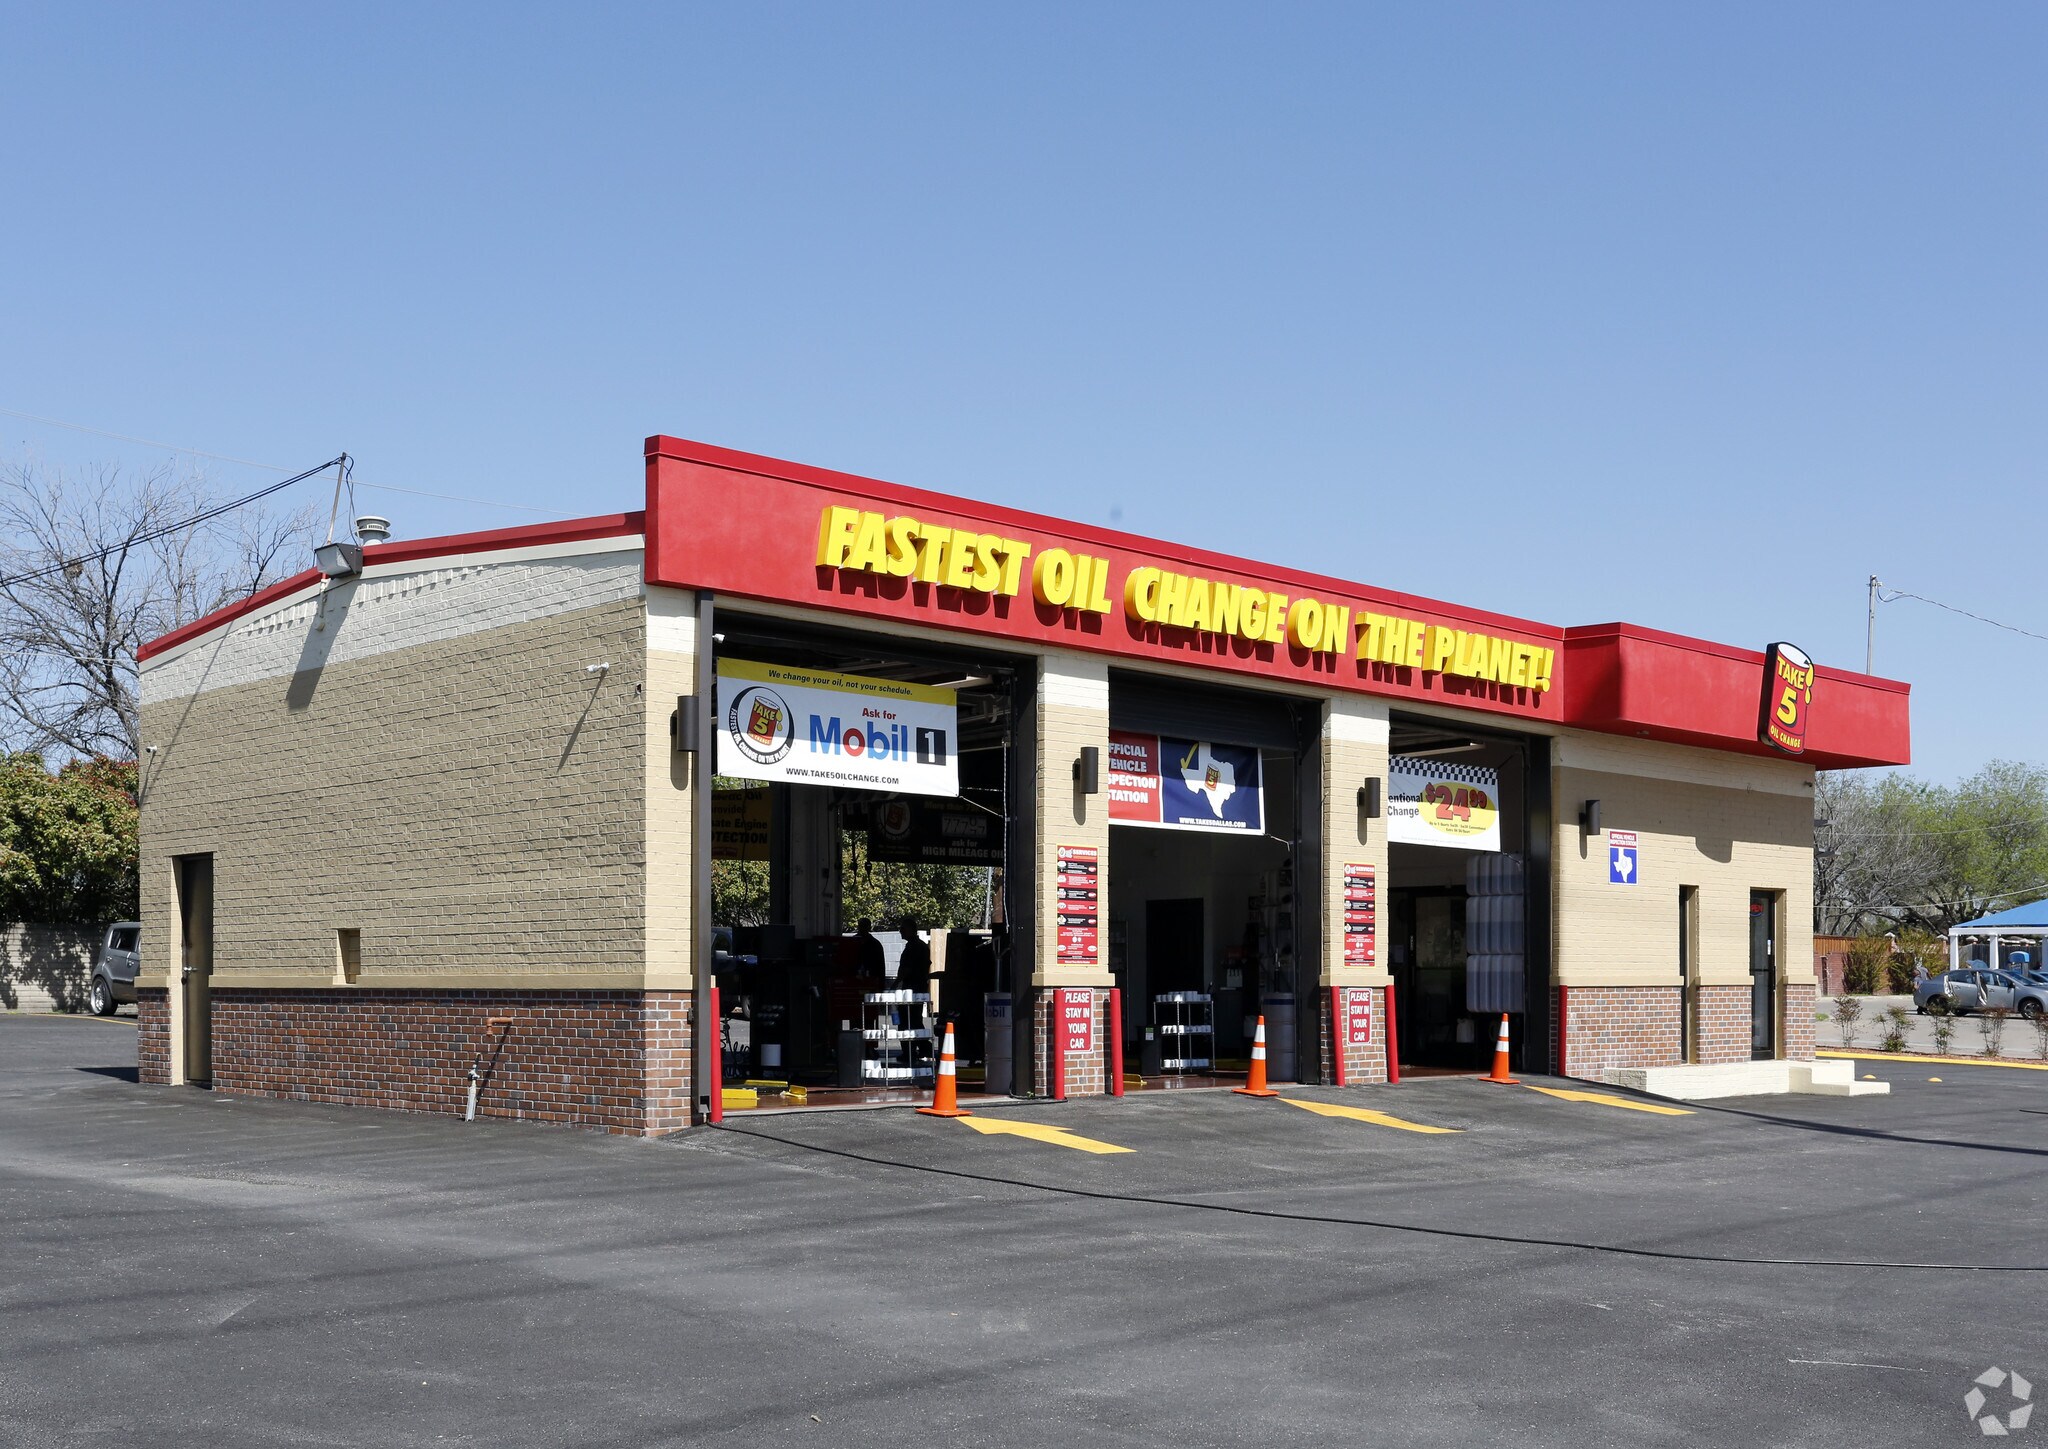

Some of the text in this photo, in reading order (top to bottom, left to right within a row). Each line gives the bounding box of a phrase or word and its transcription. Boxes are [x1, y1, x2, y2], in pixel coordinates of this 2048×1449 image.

[816, 505, 1555, 693] FASTEST OIL CHANGE ON THE PLANET!
[1777, 655, 1806, 690] TAKE
[768, 670, 913, 696] We change your oil, not your schedule.
[753, 702, 776, 721] TAKE
[1776, 686, 1797, 727] 5
[862, 707, 897, 720] Ask for
[753, 717, 769, 735] 5
[809, 714, 908, 762] Mobil
[1770, 725, 1801, 748] OIL CHANGE
[1108, 742, 1148, 757] FFICIAL
[786, 767, 900, 785] WWW.TAKE5OILCHANGE.COM
[1108, 773, 1157, 789] SPECTION
[1388, 792, 1424, 803] entional
[711, 804, 746, 814] rovides
[1387, 806, 1419, 818] Change
[735, 818, 768, 831] Engine
[711, 831, 768, 844] TECTION
[951, 839, 978, 848] ask for
[922, 846, 946, 856] HIGH
[948, 847, 989, 858] MILEAGE
[1065, 992, 1090, 1004] PLEASE
[1350, 992, 1370, 1002] PLEASE
[1065, 1007, 1090, 1018] STAY IN
[1350, 1005, 1370, 1015] STAY IN
[1068, 1023, 1087, 1034] YOUR
[1352, 1019, 1367, 1028] YOUR
[1070, 1038, 1085, 1049] CAR
[1353, 1032, 1366, 1042] CAR
